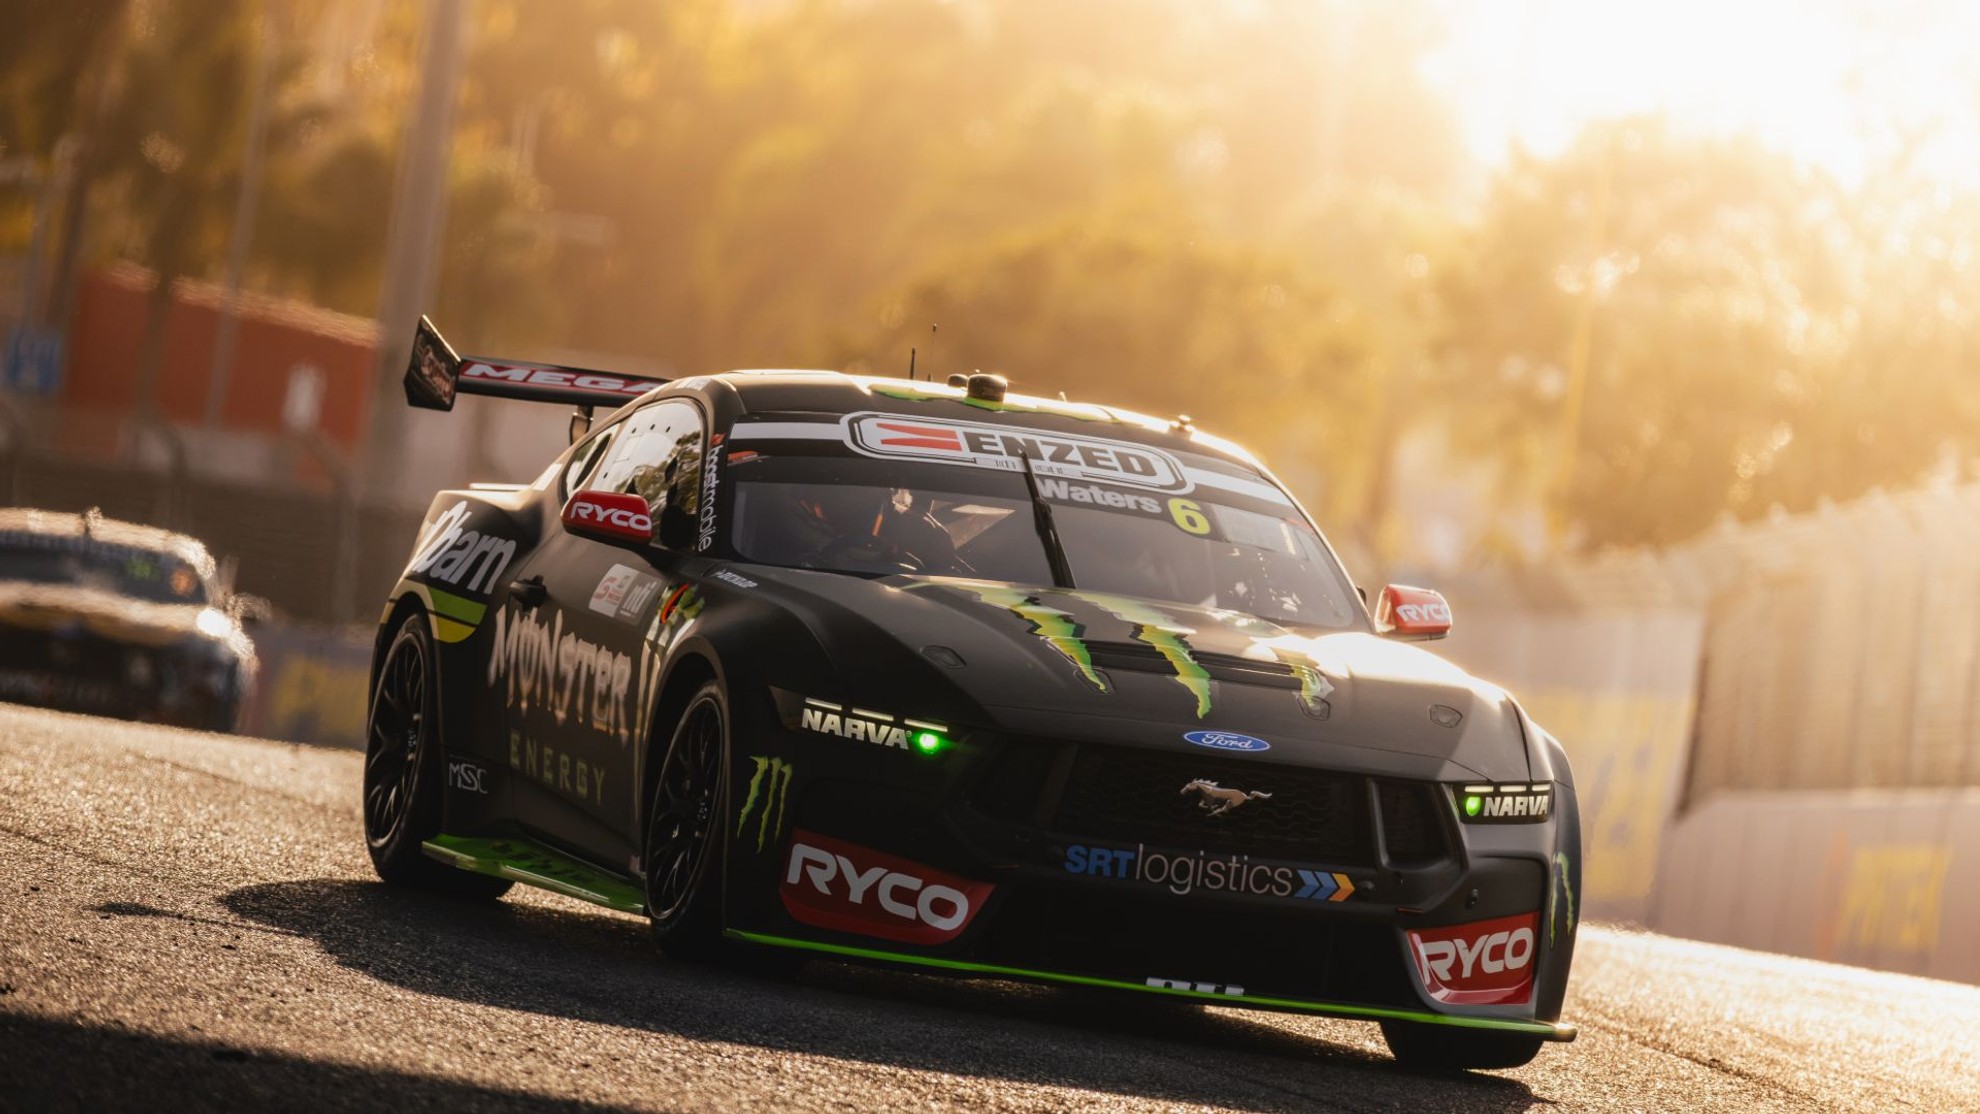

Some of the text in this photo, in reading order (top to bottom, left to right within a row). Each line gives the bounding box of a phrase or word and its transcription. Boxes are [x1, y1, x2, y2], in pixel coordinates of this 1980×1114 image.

[963, 431, 1158, 477] ENZED
[570, 501, 652, 531] RYCO
[1035, 477, 1211, 534] Waters 6
[487, 604, 632, 746] MONSTER
[509, 731, 606, 806] ENERGY
[1201, 733, 1254, 749] Ford
[1484, 795, 1549, 817] NARVA
[786, 842, 969, 931] RYCO
[1416, 927, 1534, 985] RYCO
